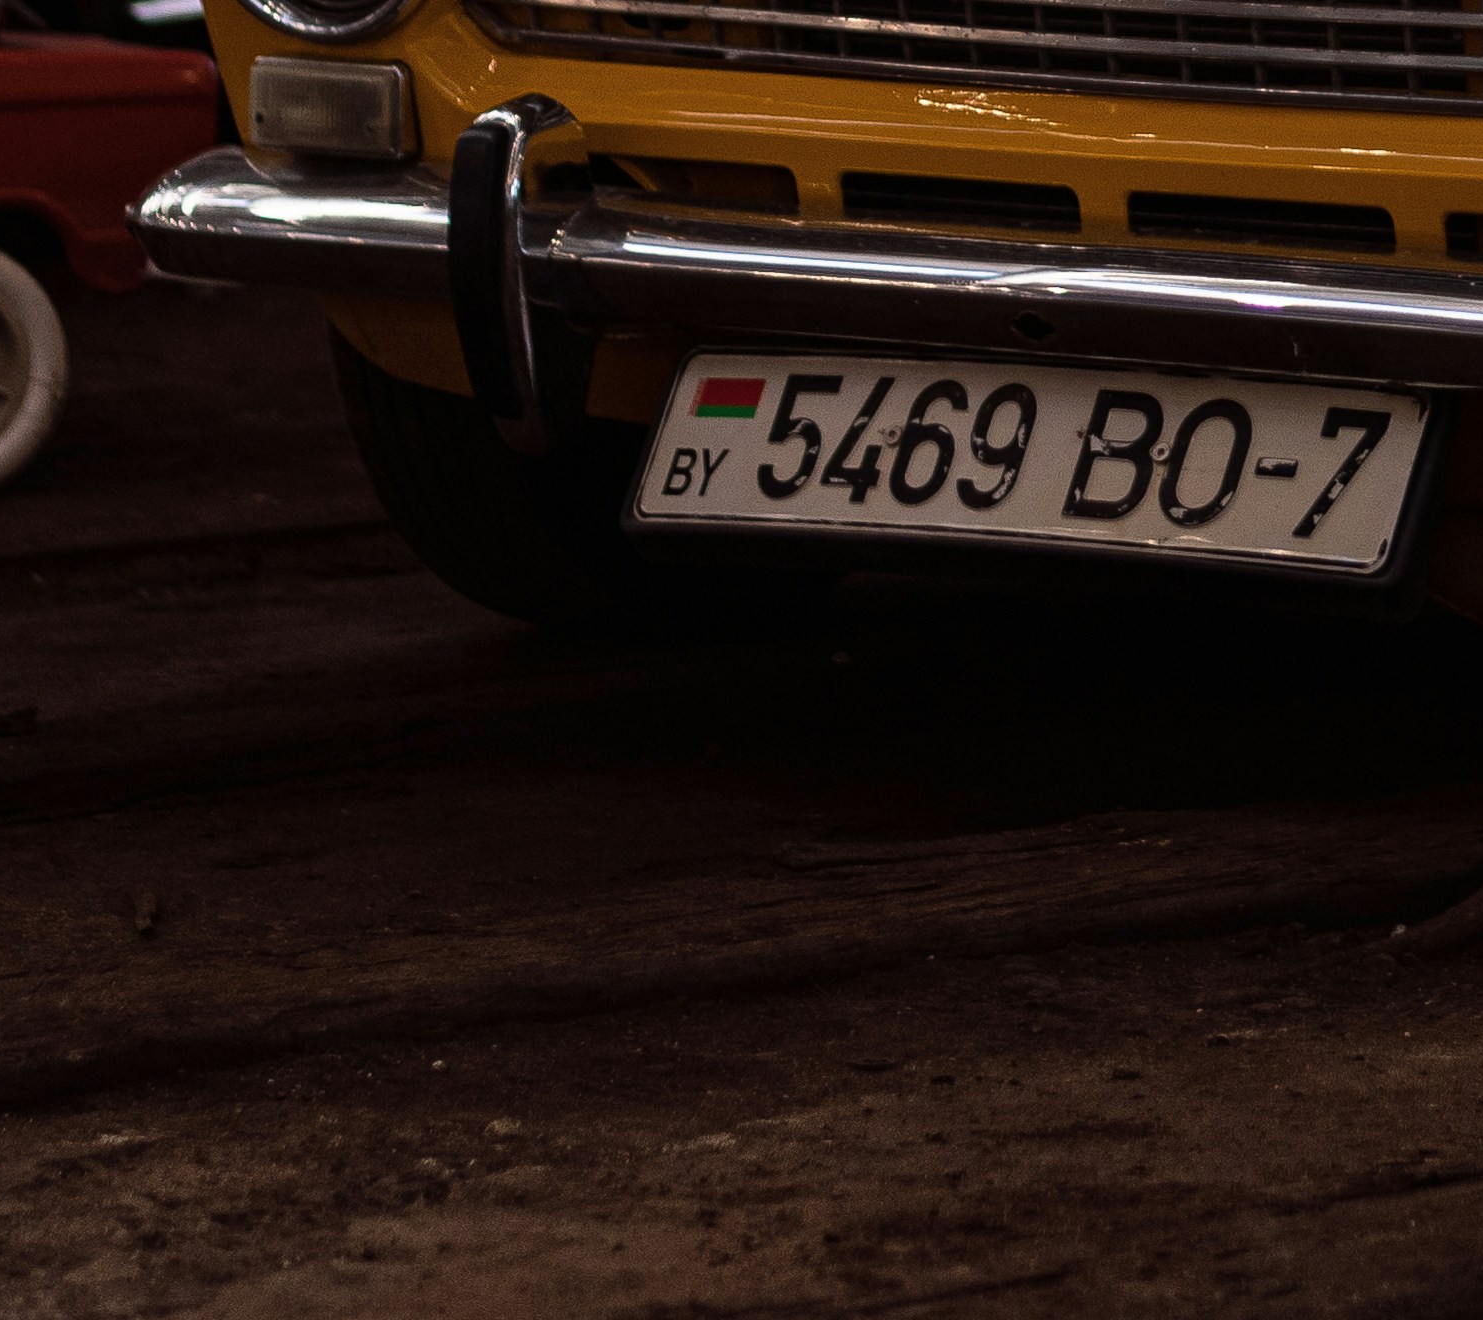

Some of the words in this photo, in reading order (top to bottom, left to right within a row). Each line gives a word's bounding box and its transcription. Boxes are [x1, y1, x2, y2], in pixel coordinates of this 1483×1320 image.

[662, 447, 728, 498] BY
[756, 373, 1038, 510] 5469
[1062, 389, 1392, 539] BO-7
